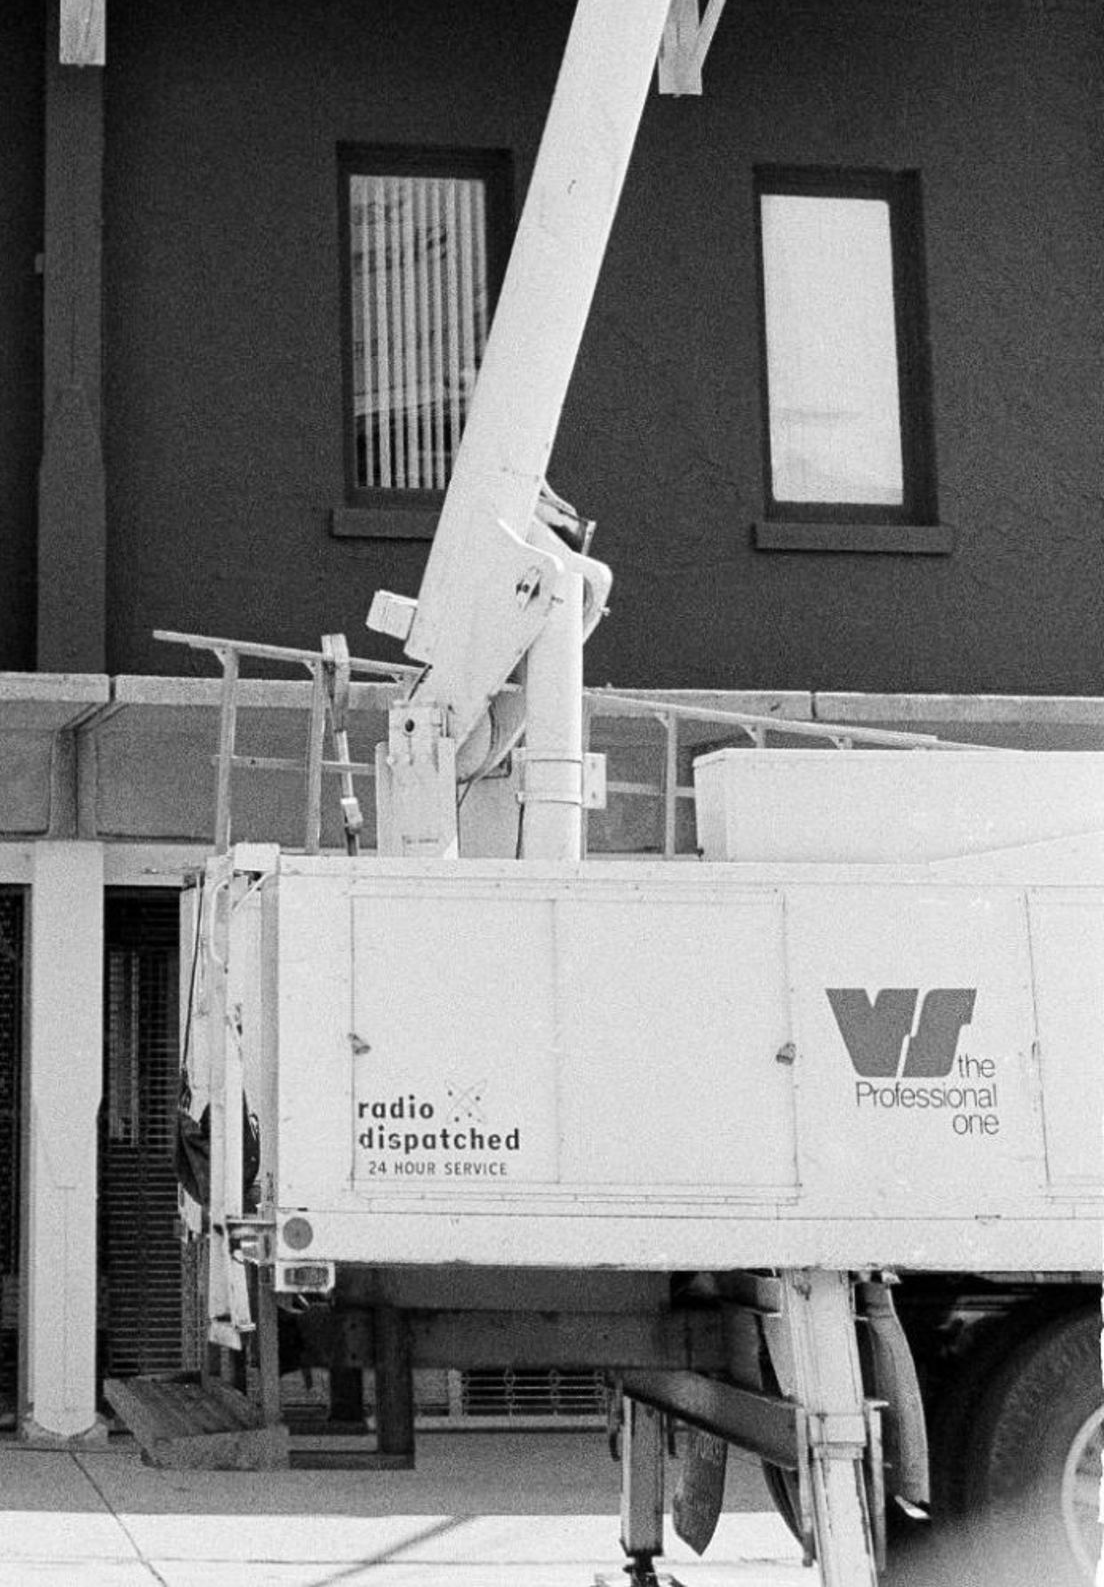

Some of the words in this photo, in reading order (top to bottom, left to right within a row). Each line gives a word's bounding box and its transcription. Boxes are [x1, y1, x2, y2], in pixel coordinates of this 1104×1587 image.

[958, 1053, 995, 1078] the
[358, 1094, 434, 1119] radio
[855, 1081, 997, 1108] Professional
[952, 1114, 999, 1135] one
[359, 1125, 520, 1155] dispatched
[369, 1161, 387, 1175] 24
[395, 1161, 436, 1175] HOUR
[445, 1162, 507, 1176] SERVICE
